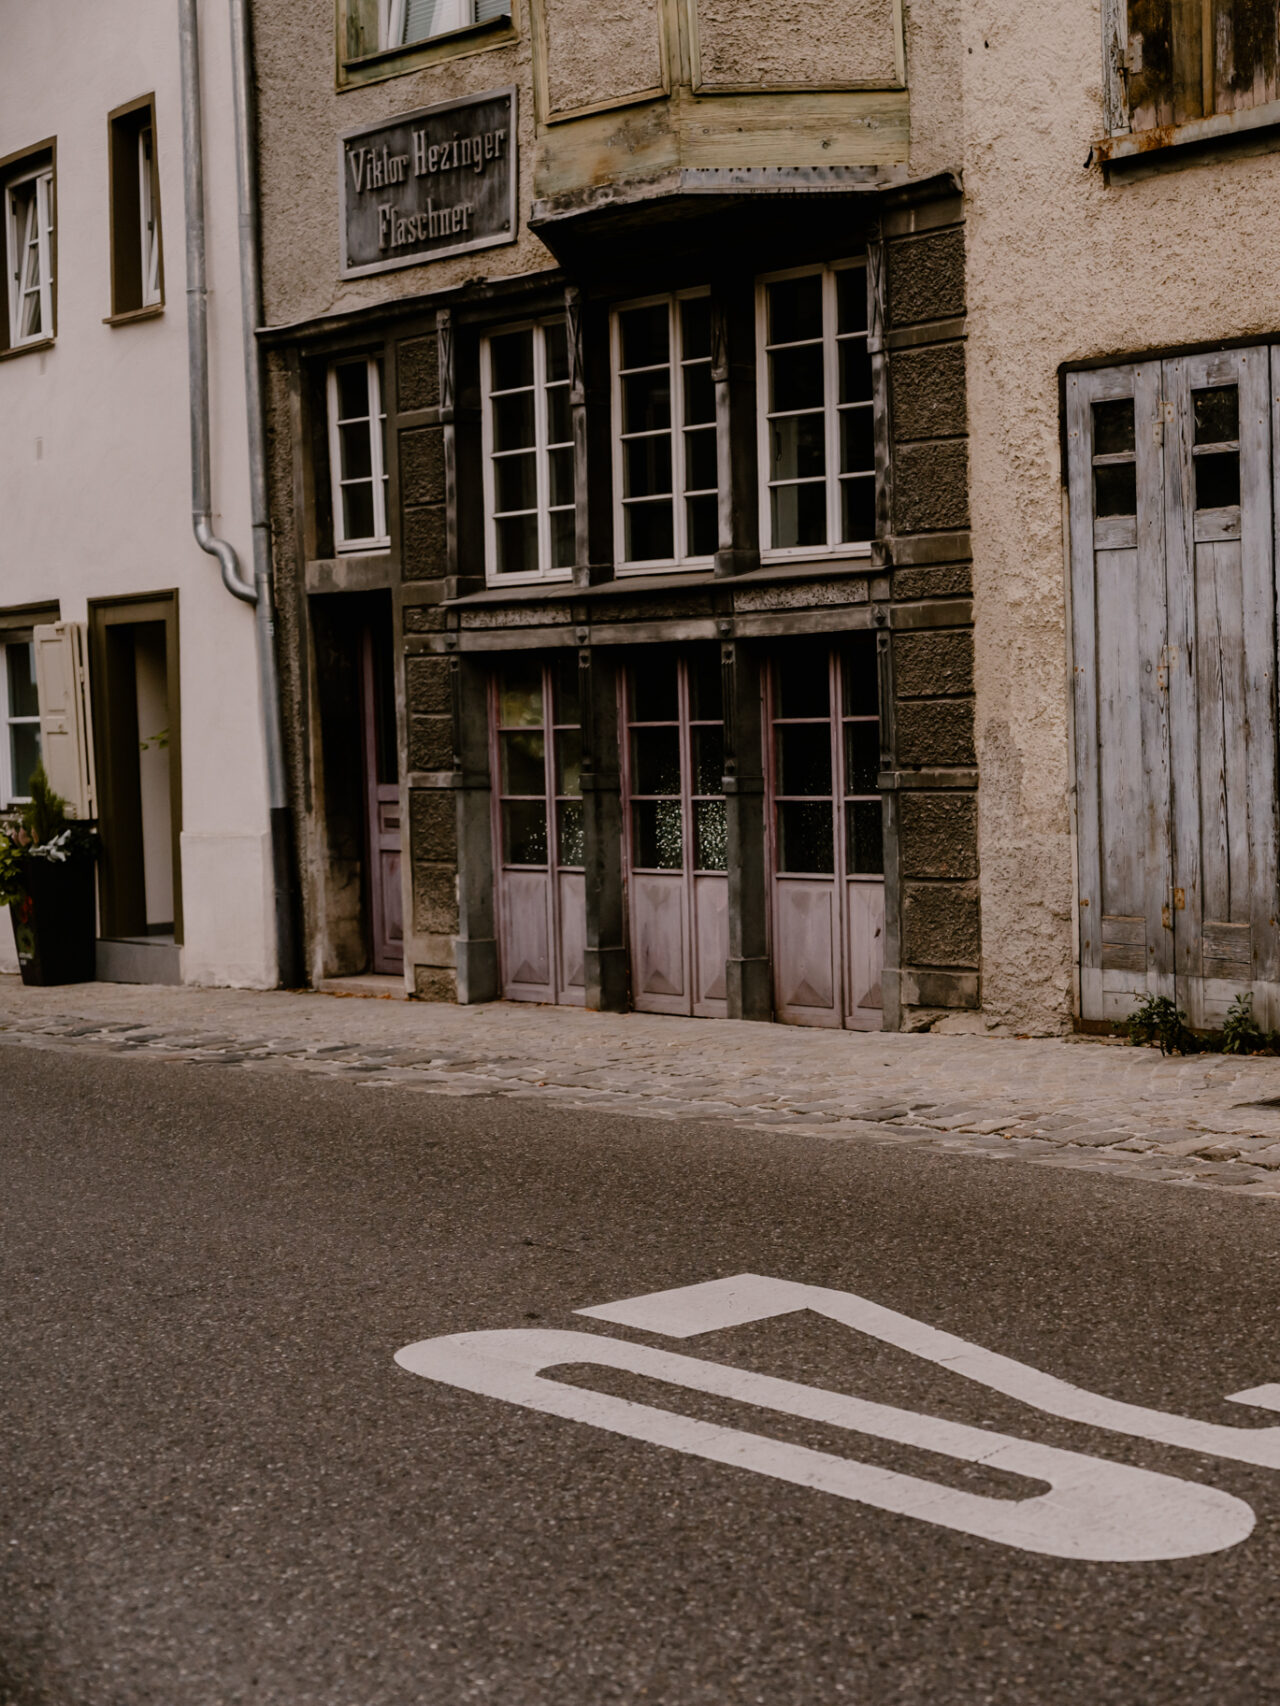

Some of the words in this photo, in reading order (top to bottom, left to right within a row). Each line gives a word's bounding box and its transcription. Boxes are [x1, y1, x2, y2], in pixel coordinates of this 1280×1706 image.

[349, 144, 409, 193] Viktor
[412, 128, 507, 177] Hezinger
[377, 198, 474, 251] Flaschner
